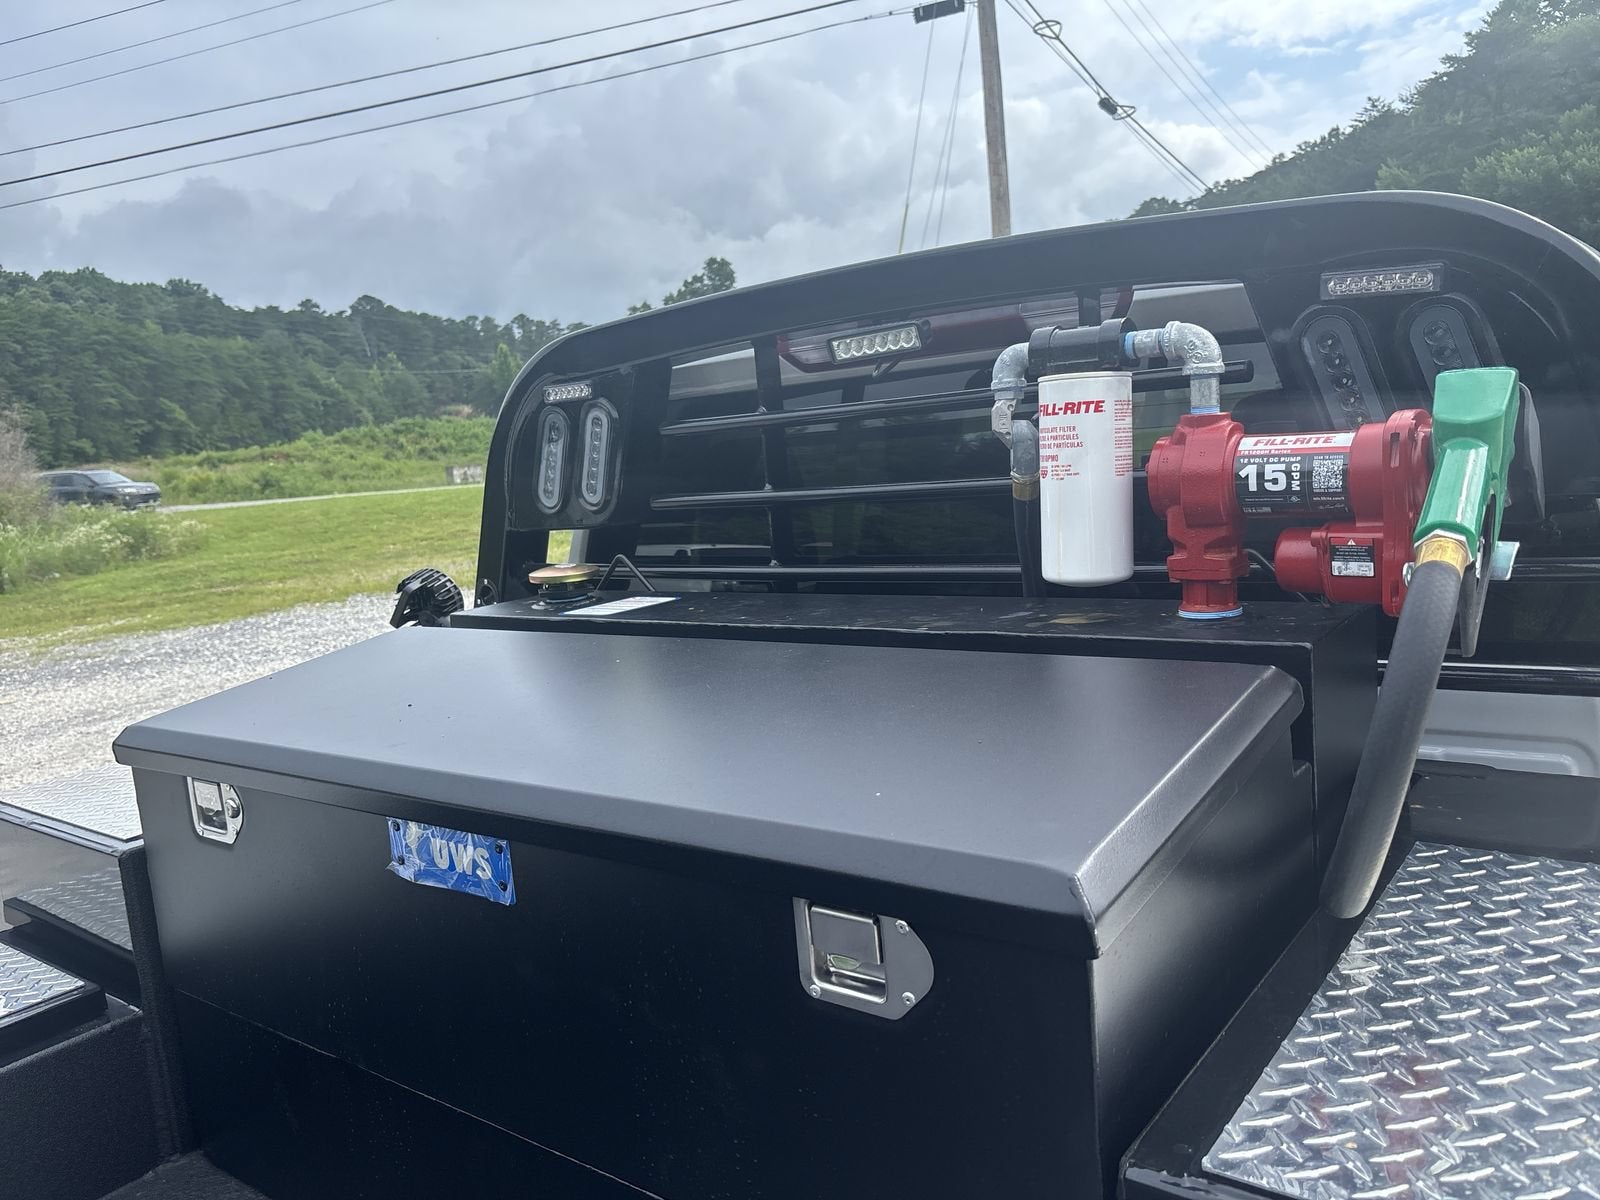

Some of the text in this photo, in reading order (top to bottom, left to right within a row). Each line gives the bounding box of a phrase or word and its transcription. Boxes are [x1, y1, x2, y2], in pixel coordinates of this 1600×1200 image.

[1040, 400, 1105, 416] FILL-RITE
[1050, 433, 1079, 441] PARTICULES
[1253, 435, 1336, 447] FILL-RITE
[1238, 463, 1287, 492] 15
[1291, 463, 1301, 491] GPM
[431, 837, 492, 880] UWS
